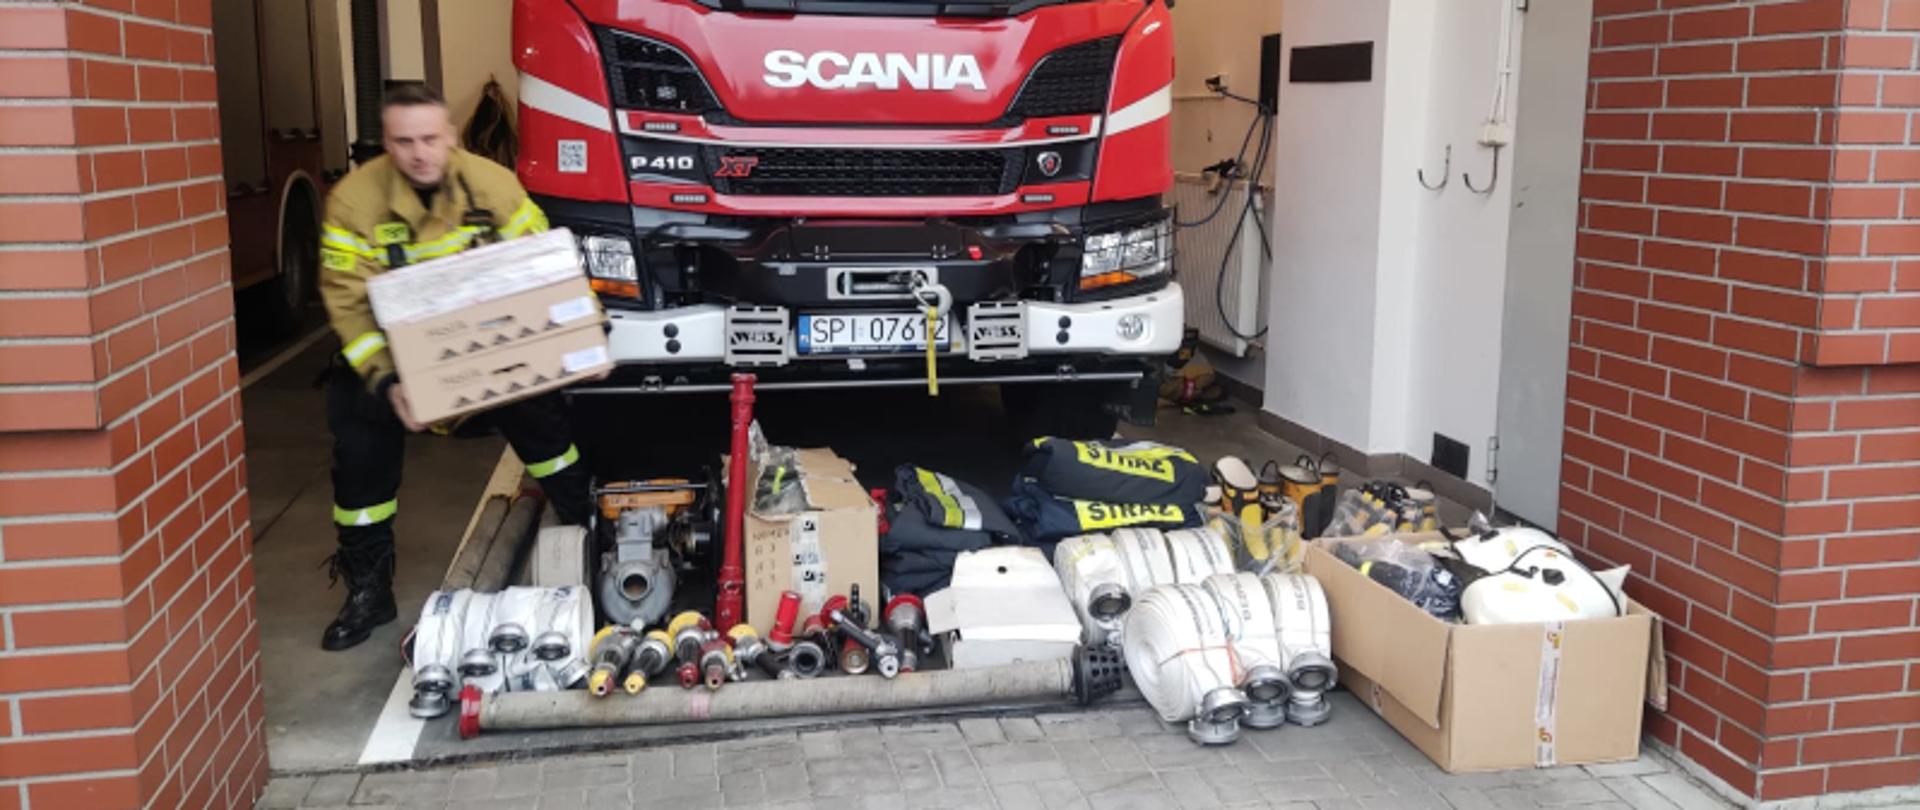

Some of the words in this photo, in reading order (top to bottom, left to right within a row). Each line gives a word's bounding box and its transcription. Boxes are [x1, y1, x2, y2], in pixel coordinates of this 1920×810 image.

[763, 50, 987, 90] SCANIA
[630, 155, 648, 169] P
[650, 155, 695, 169] 410
[714, 156, 759, 177] XT
[813, 317, 856, 343] SPI
[870, 317, 946, 341] 07612
